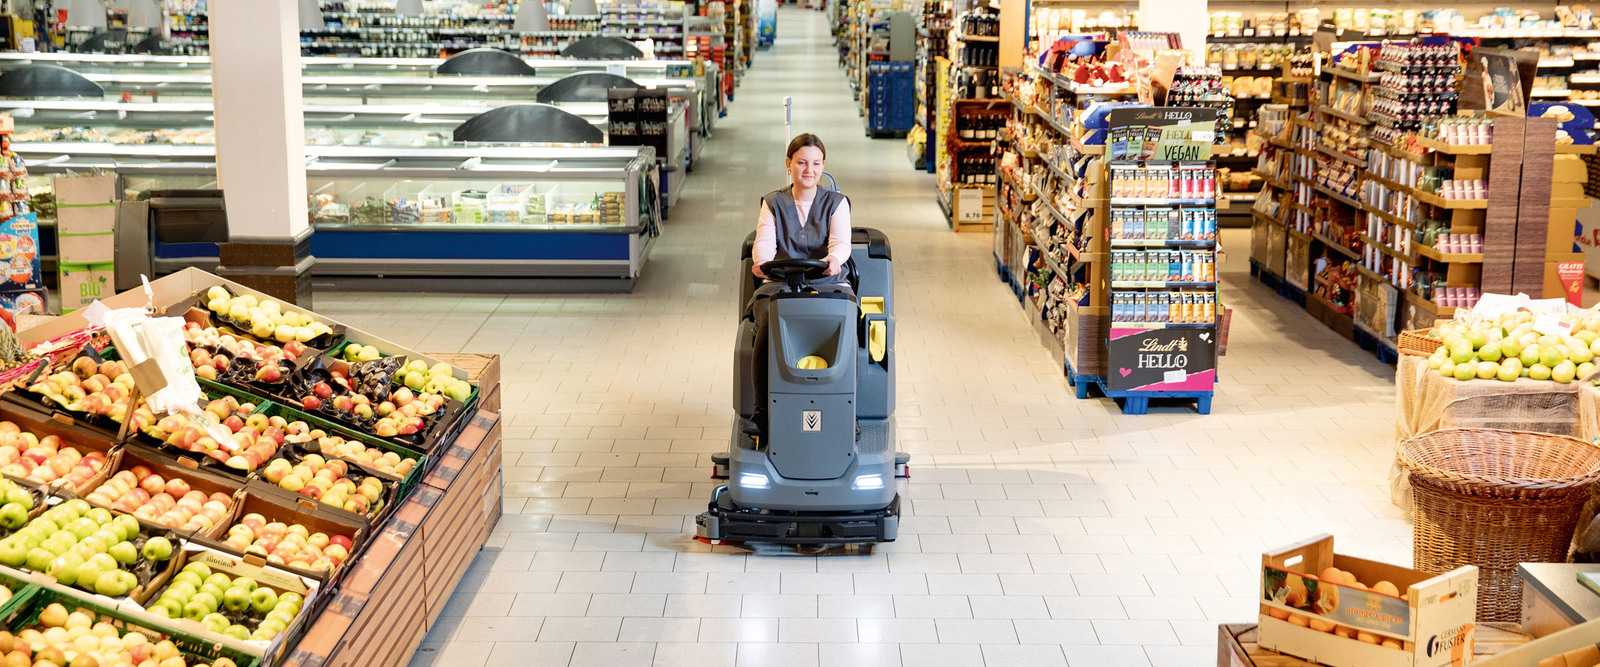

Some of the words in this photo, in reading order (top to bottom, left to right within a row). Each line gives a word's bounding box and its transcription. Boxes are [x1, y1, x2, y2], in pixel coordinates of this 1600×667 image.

[1164, 111, 1193, 120] HELLO
[1164, 145, 1200, 160] VEGAN
[80, 282, 102, 297] BIO
[1138, 338, 1179, 351] Lindt
[1138, 354, 1187, 368] HELLO
